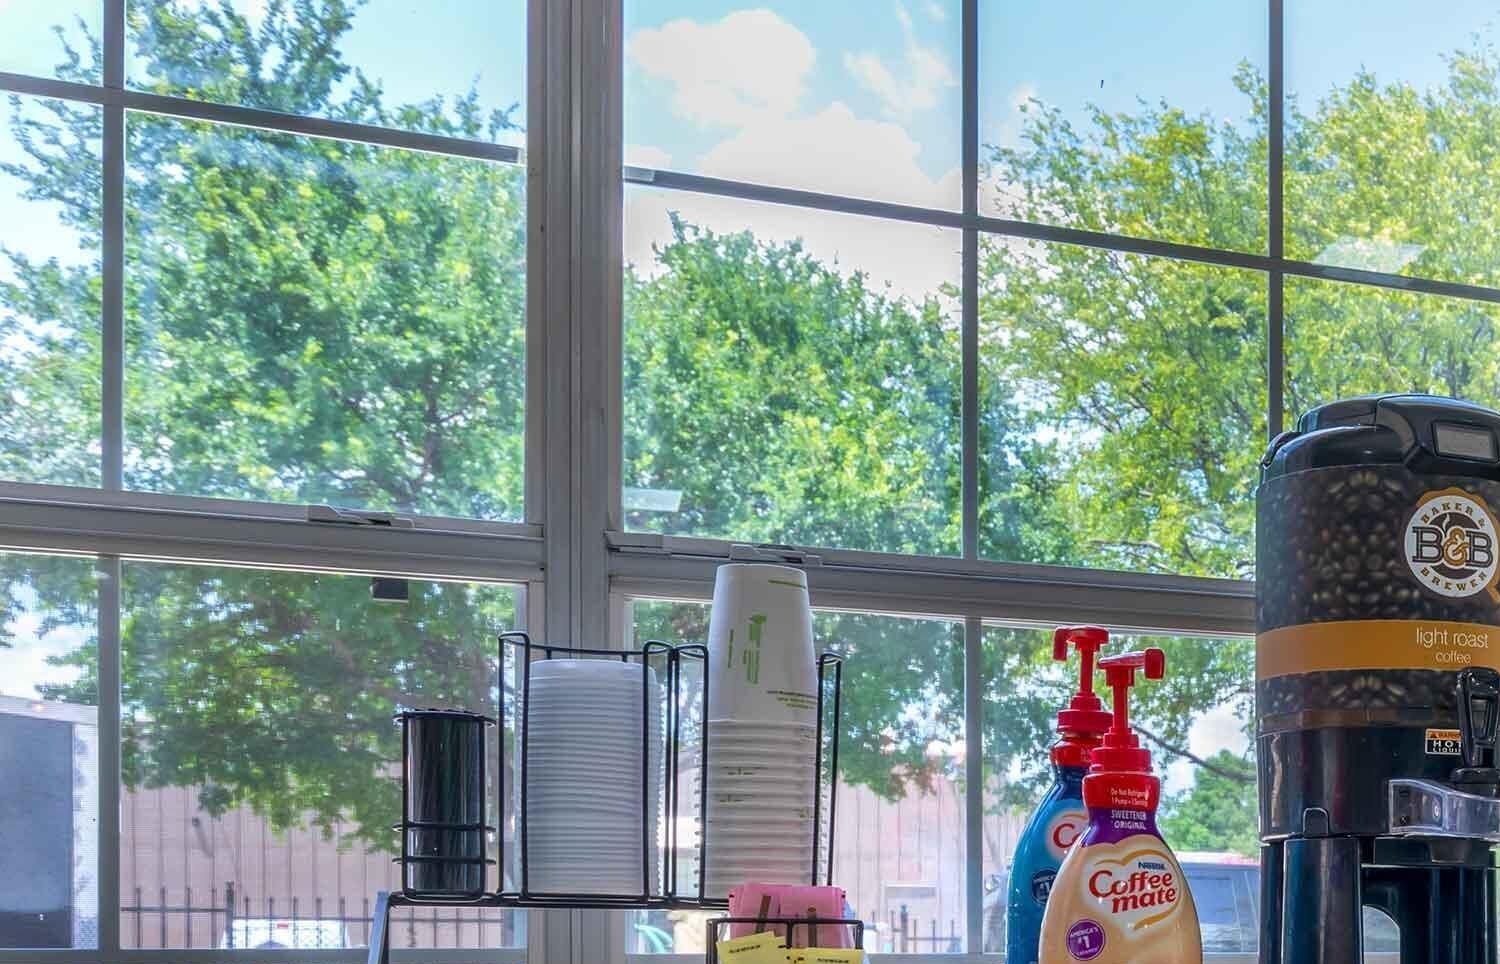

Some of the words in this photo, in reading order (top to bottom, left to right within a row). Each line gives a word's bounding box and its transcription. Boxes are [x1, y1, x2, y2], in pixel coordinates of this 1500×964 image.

[1421, 502, 1474, 524] BAKER
[1412, 526, 1493, 568] B&B
[1420, 567, 1487, 591] BREWER
[1416, 627, 1448, 649] light
[1453, 632, 1489, 649] roast
[1113, 820, 1147, 830] ORIGINAL
[1089, 869, 1173, 898] Coffee
[1112, 887, 1176, 913] mate
